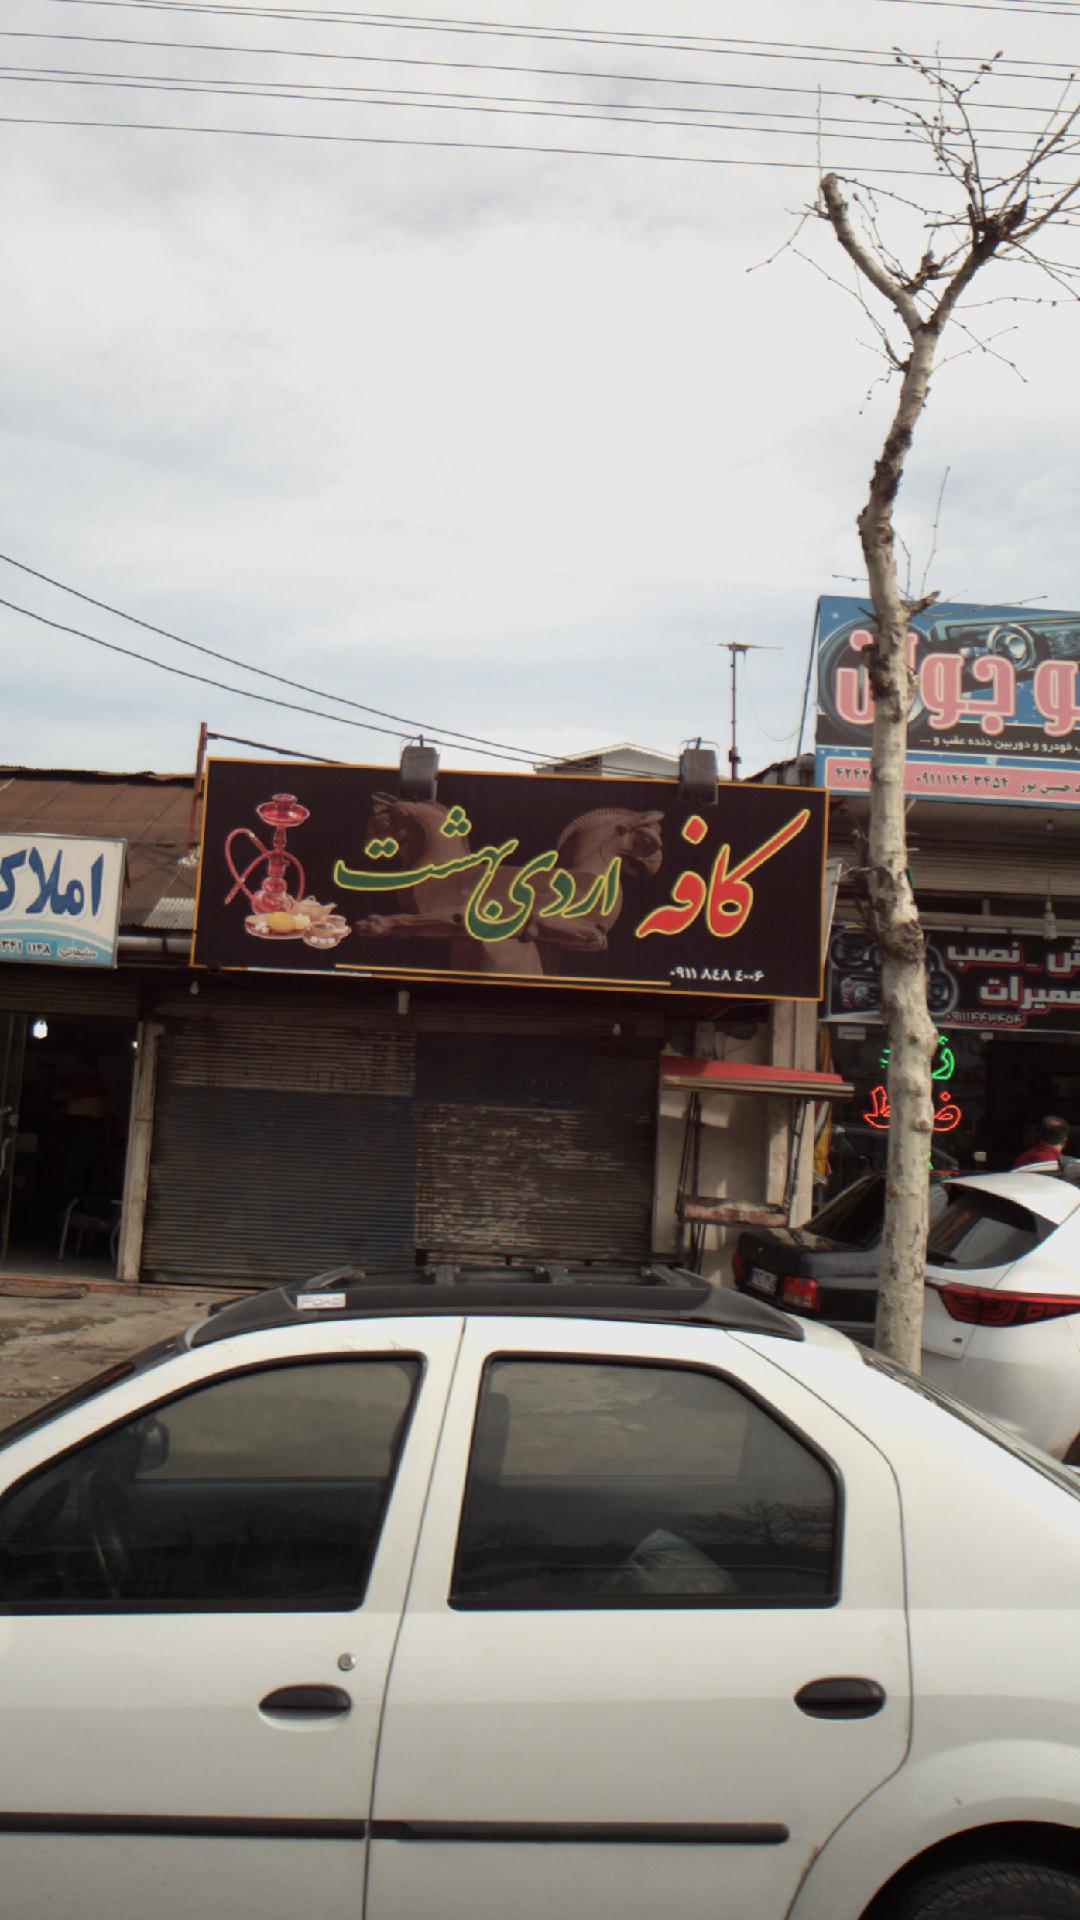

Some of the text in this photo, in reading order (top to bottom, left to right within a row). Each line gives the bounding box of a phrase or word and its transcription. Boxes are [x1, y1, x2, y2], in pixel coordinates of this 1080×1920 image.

[942, 735, 966, 748] عقب
[968, 738, 993, 746] دنده
[994, 740, 1031, 750] دوربین
[1042, 741, 1073, 753] خودرو
[635, 809, 811, 939] کافه
[947, 941, 1020, 967] نصب
